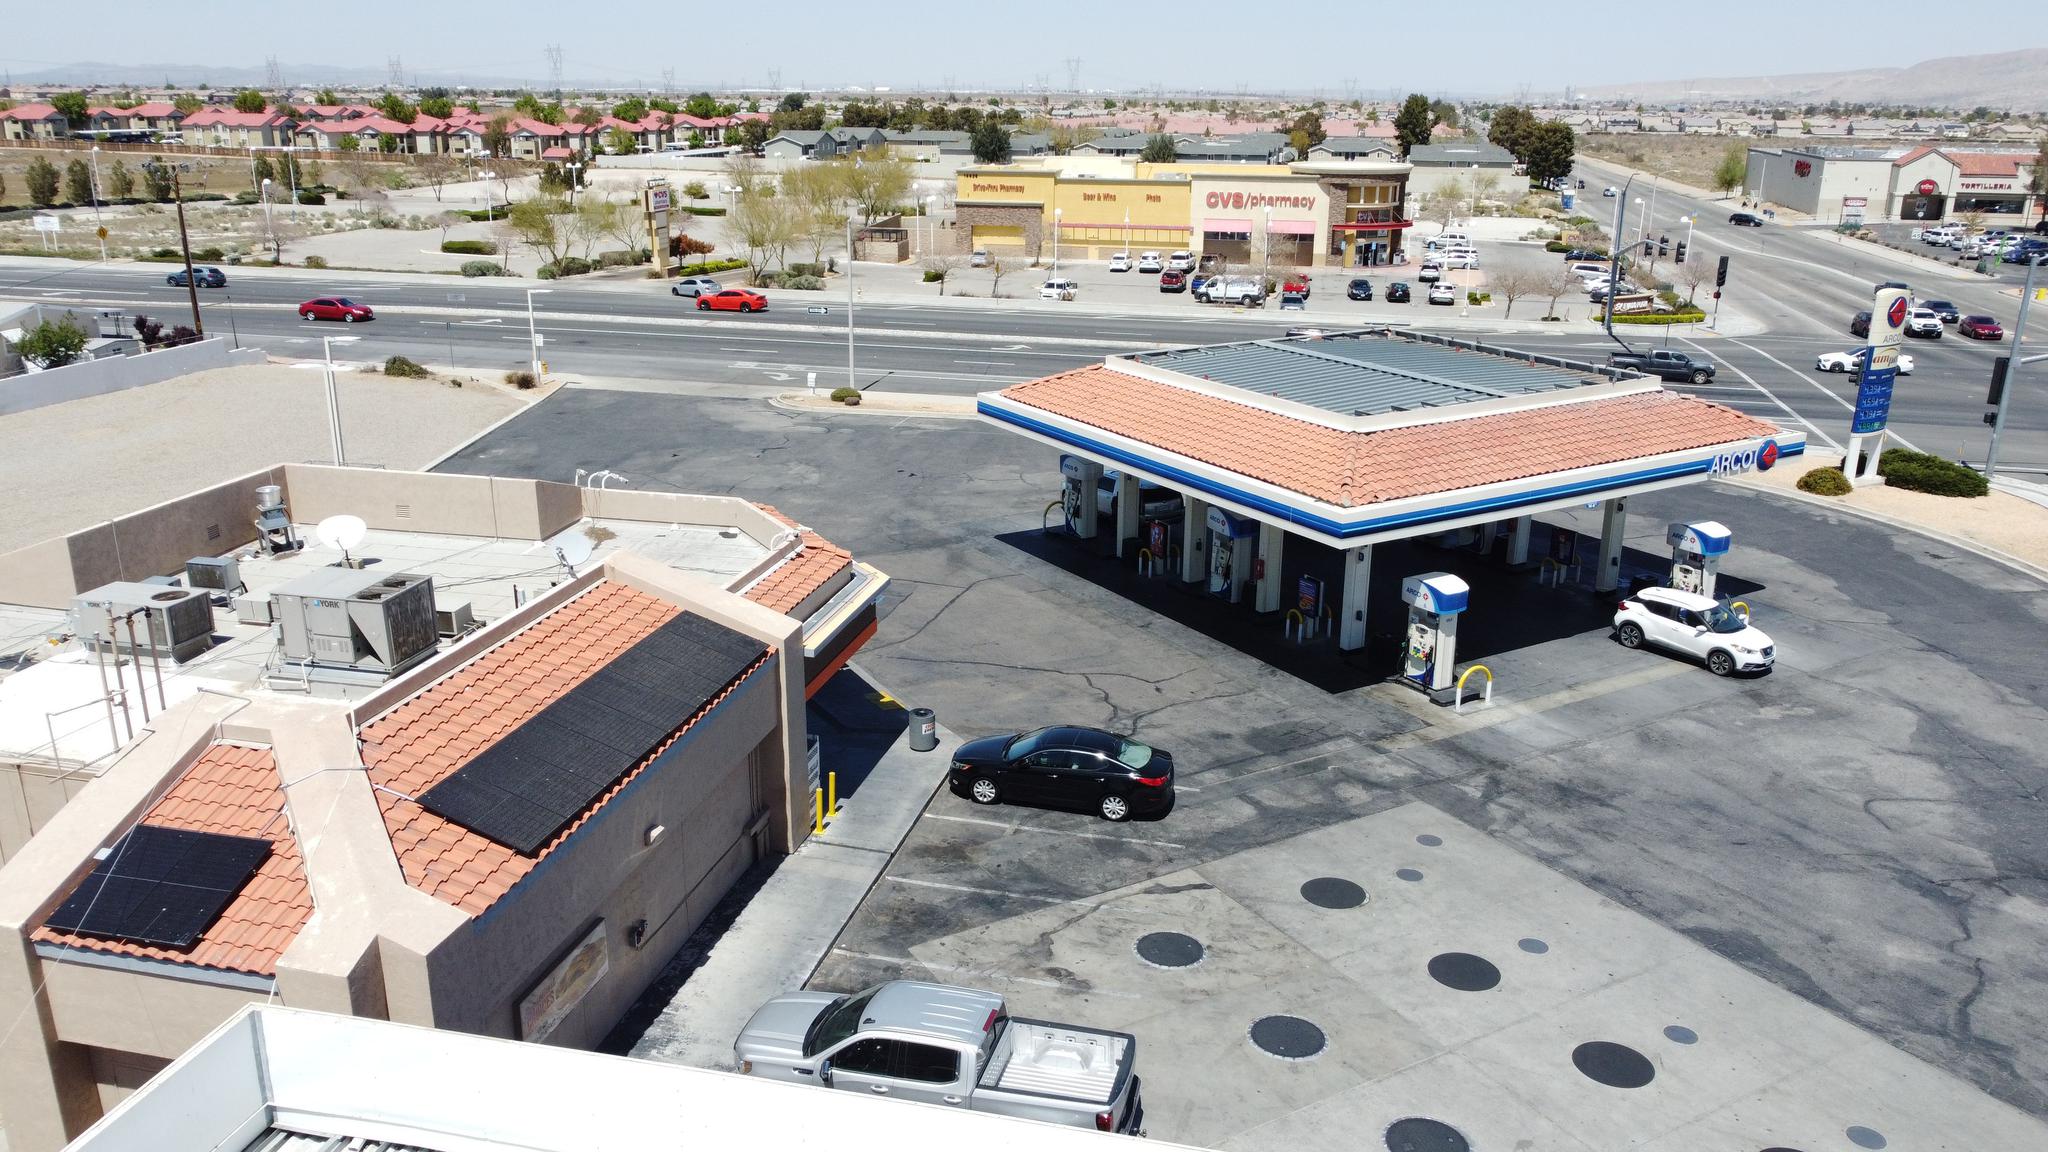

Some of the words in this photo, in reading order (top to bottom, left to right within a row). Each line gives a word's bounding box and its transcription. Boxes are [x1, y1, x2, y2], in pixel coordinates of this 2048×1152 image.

[1000, 184, 1025, 194] Pharmacy
[1882, 333, 1901, 343] ARCO
[1709, 449, 1754, 474] ARCO
[1671, 532, 1689, 541] ARCO
[1406, 587, 1421, 597] ARCO
[320, 599, 340, 608] YORK
